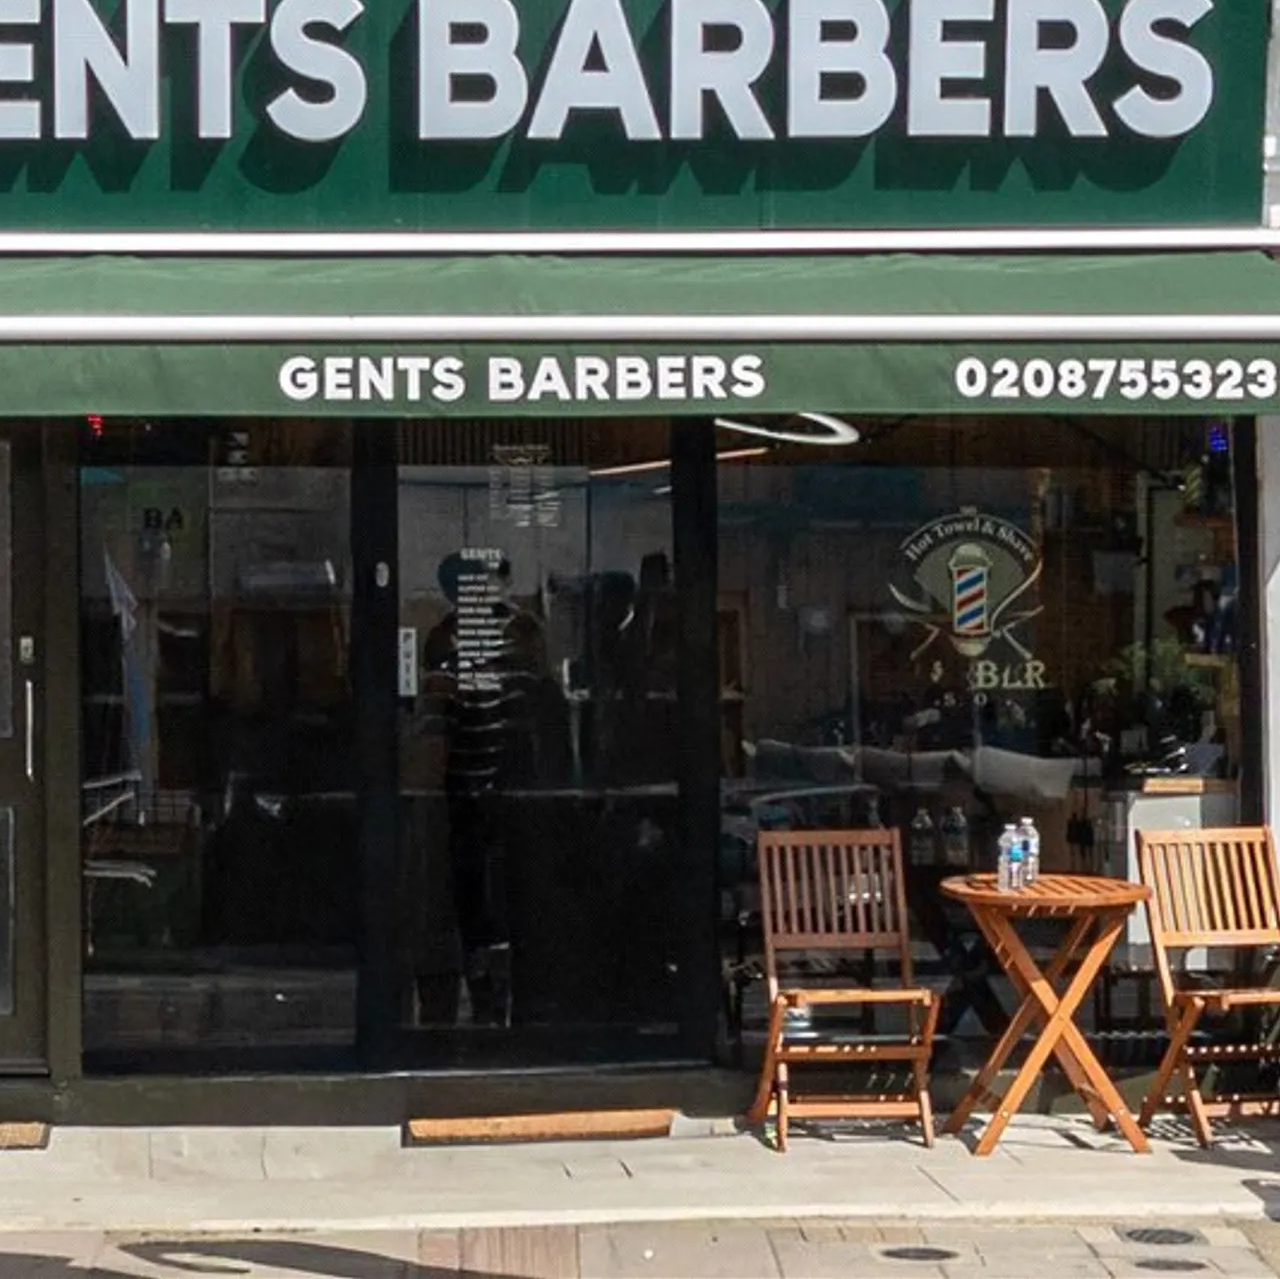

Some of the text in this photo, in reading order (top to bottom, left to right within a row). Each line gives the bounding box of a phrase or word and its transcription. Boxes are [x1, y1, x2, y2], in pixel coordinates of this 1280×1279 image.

[279, 354, 766, 401] GENTS BARBERS
[932, 518, 980, 538] Towel
